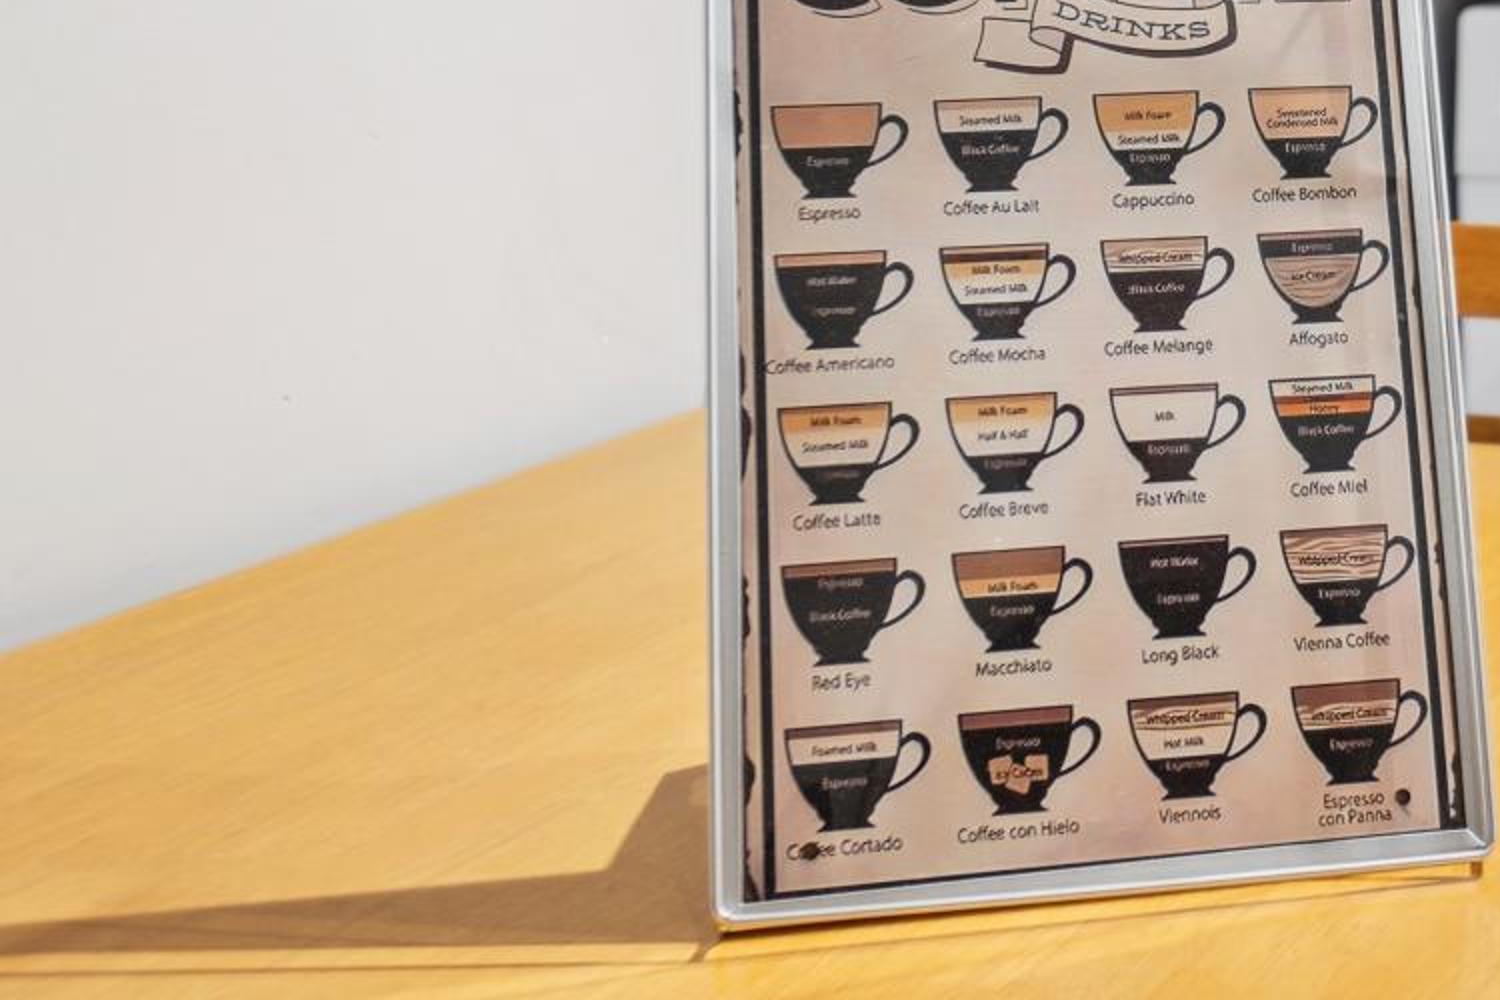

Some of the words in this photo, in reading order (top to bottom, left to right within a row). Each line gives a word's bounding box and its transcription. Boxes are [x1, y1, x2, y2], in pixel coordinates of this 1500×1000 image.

[1113, 192, 1194, 211] Cappuccino
[1253, 187, 1295, 203] Coffee
[1299, 185, 1357, 200] Bombon
[798, 207, 860, 222] Espresso
[944, 202, 989, 217] Coffee
[992, 201, 1011, 214] Au
[1014, 200, 1039, 213] Lait
[1104, 340, 1149, 357] Coffee
[1153, 338, 1213, 356] Melange
[1289, 332, 1349, 349] Affogato
[949, 349, 994, 365] Coffee
[998, 347, 1046, 361] Mocha
[766, 359, 812, 375] Coffee
[816, 356, 895, 372] Americano
[1291, 482, 1335, 497] Coffee
[1338, 479, 1368, 494] Miel
[1136, 491, 1164, 507] Flat
[1167, 488, 1207, 504] White
[960, 503, 1006, 519] Coffee
[1009, 501, 1048, 516] Breve
[793, 515, 840, 531] Coffee
[844, 513, 881, 529] Latte
[1294, 634, 1343, 650] Vienna
[1346, 631, 1390, 647] Coffee
[1142, 649, 1178, 666] Long
[1182, 645, 1219, 661] Black
[976, 659, 1053, 677] Macchiato
[812, 675, 840, 689] Red
[845, 672, 870, 692] Eye
[1323, 793, 1385, 809] Espresso
[1159, 807, 1222, 824] Viennois
[1318, 813, 1345, 827] con
[1348, 808, 1393, 825] Panna
[957, 827, 1005, 844] Coffee
[1009, 826, 1036, 839] con
[1040, 819, 1080, 835] Hielo
[839, 836, 904, 858] Cortado
